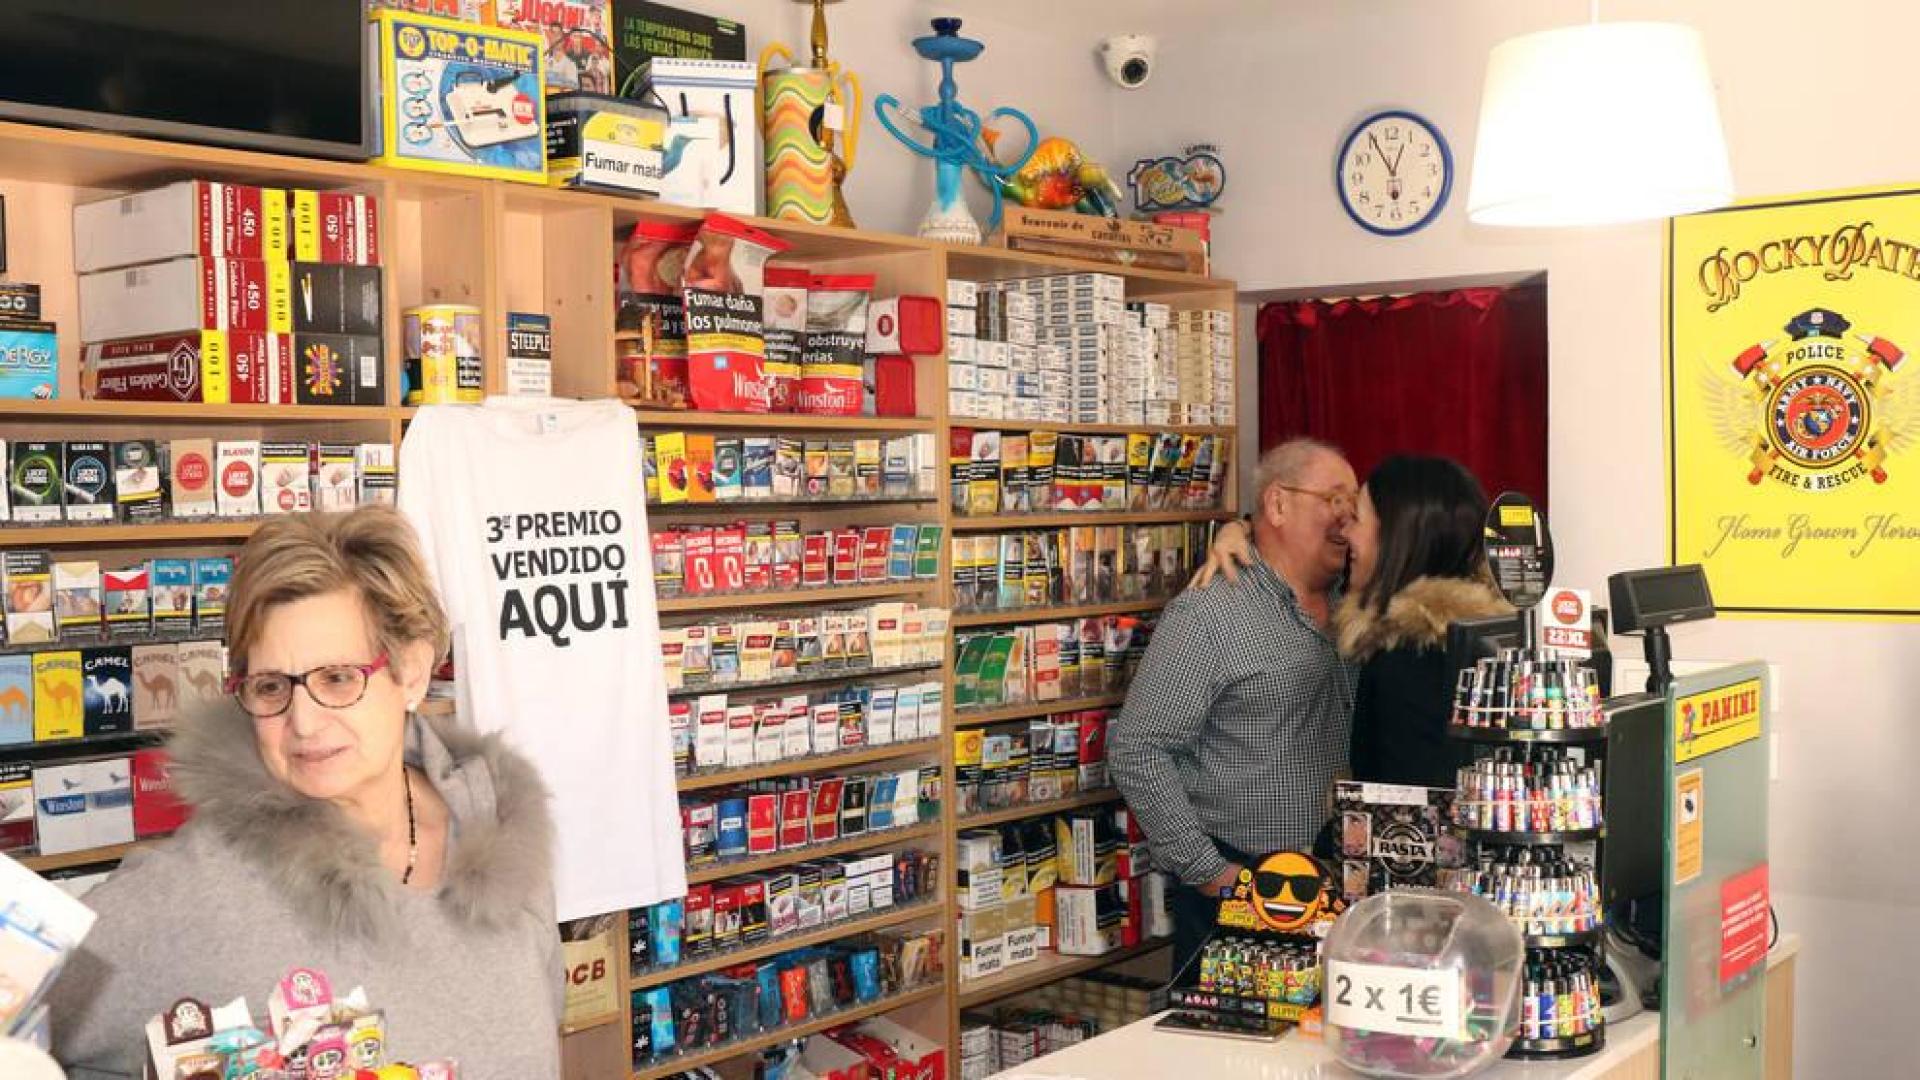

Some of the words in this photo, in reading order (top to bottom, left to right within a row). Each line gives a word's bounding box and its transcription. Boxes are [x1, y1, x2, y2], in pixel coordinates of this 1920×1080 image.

[585, 152, 630, 174] Fumar
[632, 162, 666, 180] mata
[243, 208, 255, 237] 450
[326, 214, 338, 243] 450
[1699, 235, 1830, 313] ROCKY
[248, 280, 260, 310] 450
[685, 290, 723, 308] Fumar
[686, 311, 711, 330] los
[808, 334, 865, 350] obstruye
[1787, 345, 1845, 364] POLICE
[236, 354, 249, 382] 450
[1768, 465, 1800, 488] FIRE
[1803, 477, 1812, 489] &
[1816, 462, 1868, 490] RESCUE
[516, 509, 622, 540] PREMIO
[1703, 514, 1782, 559] Home
[1782, 514, 1857, 559] Grown
[491, 543, 626, 580] VENDIDO
[500, 572, 629, 647] AQUÍ
[85, 656, 129, 671] CAMEL
[134, 653, 176, 667] CAMEL
[1702, 690, 1756, 728] PANINI
[1380, 840, 1426, 858] RASTA
[975, 941, 1002, 959] Fumar
[1008, 929, 1037, 947] Fumar
[1010, 946, 1034, 960] mata
[1335, 974, 1352, 1007] 2
[1364, 985, 1385, 1011] x
[1397, 982, 1443, 1018] 1€
